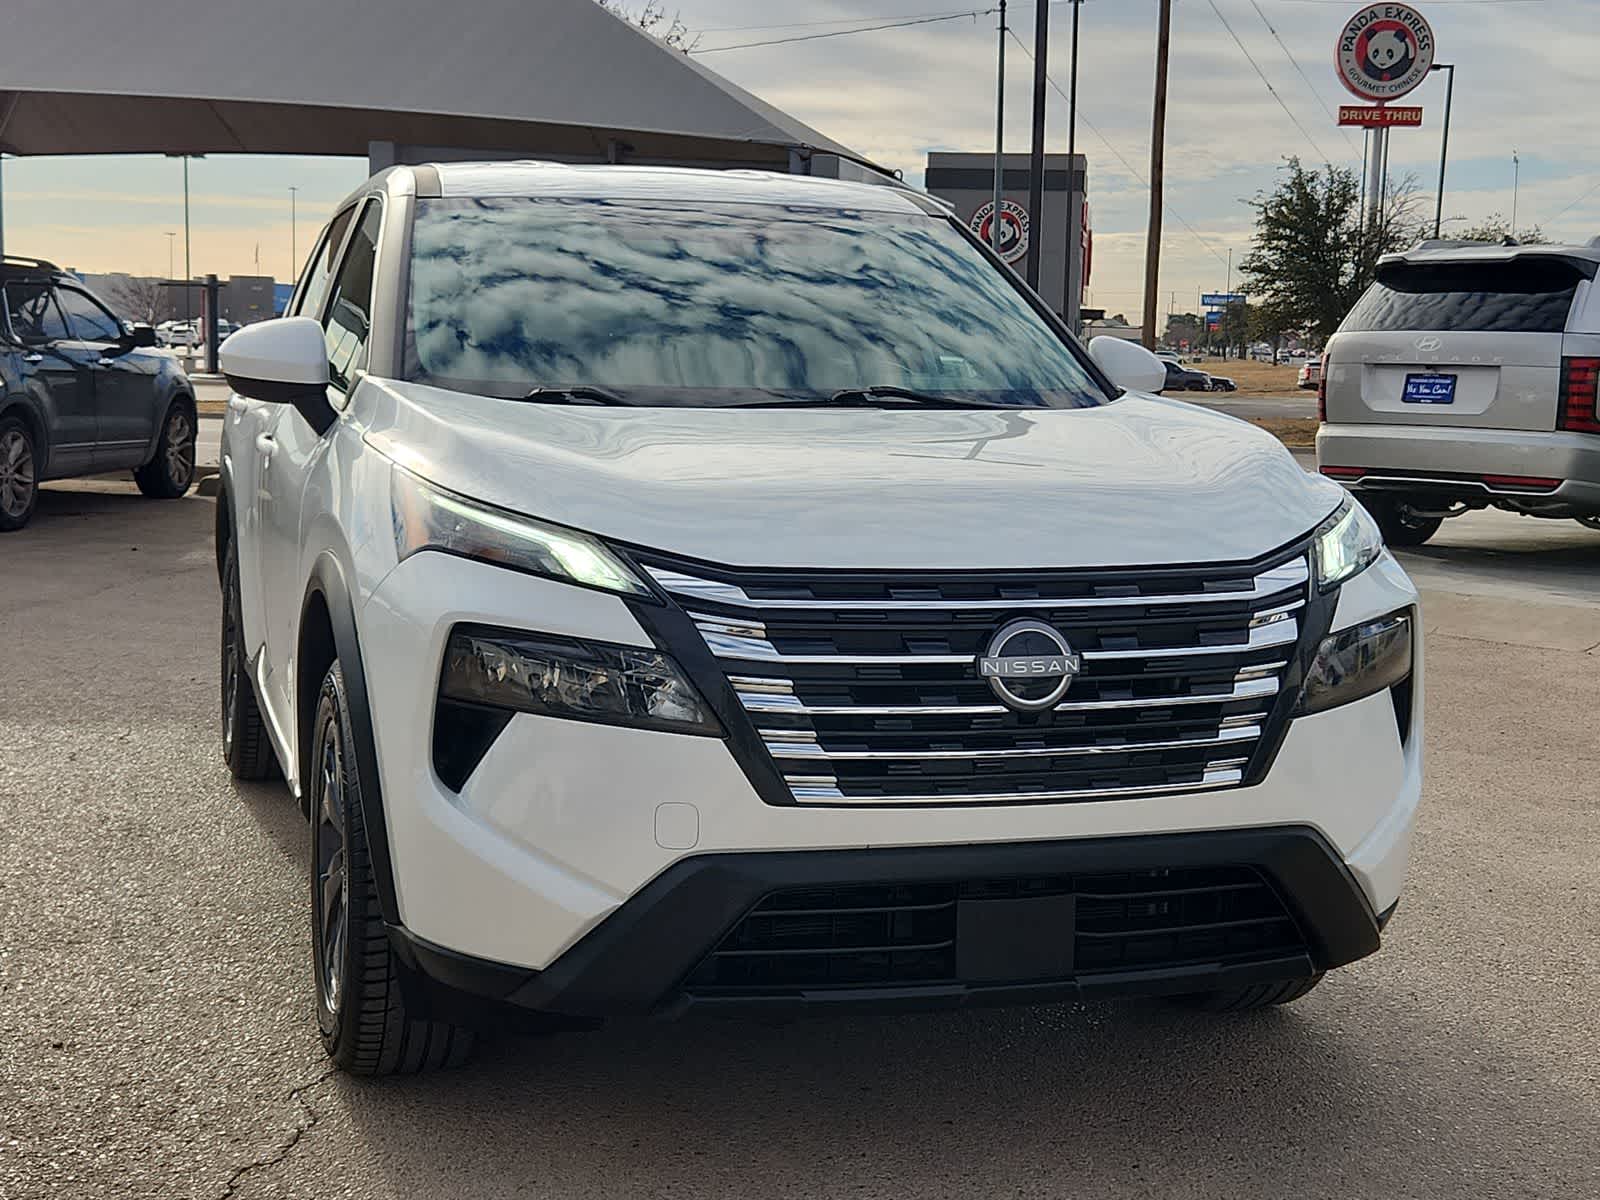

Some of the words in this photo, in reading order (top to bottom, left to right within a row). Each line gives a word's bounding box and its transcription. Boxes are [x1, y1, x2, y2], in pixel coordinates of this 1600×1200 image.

[1342, 10, 1379, 53] PANDA
[1384, 7, 1431, 51] EXPRESS
[1348, 67, 1386, 93] GOURMET
[1388, 68, 1421, 93] CHINESE
[1340, 110, 1381, 121] DRIVE
[1383, 110, 1421, 121] THRU
[983, 659, 1078, 673] NISSAN
